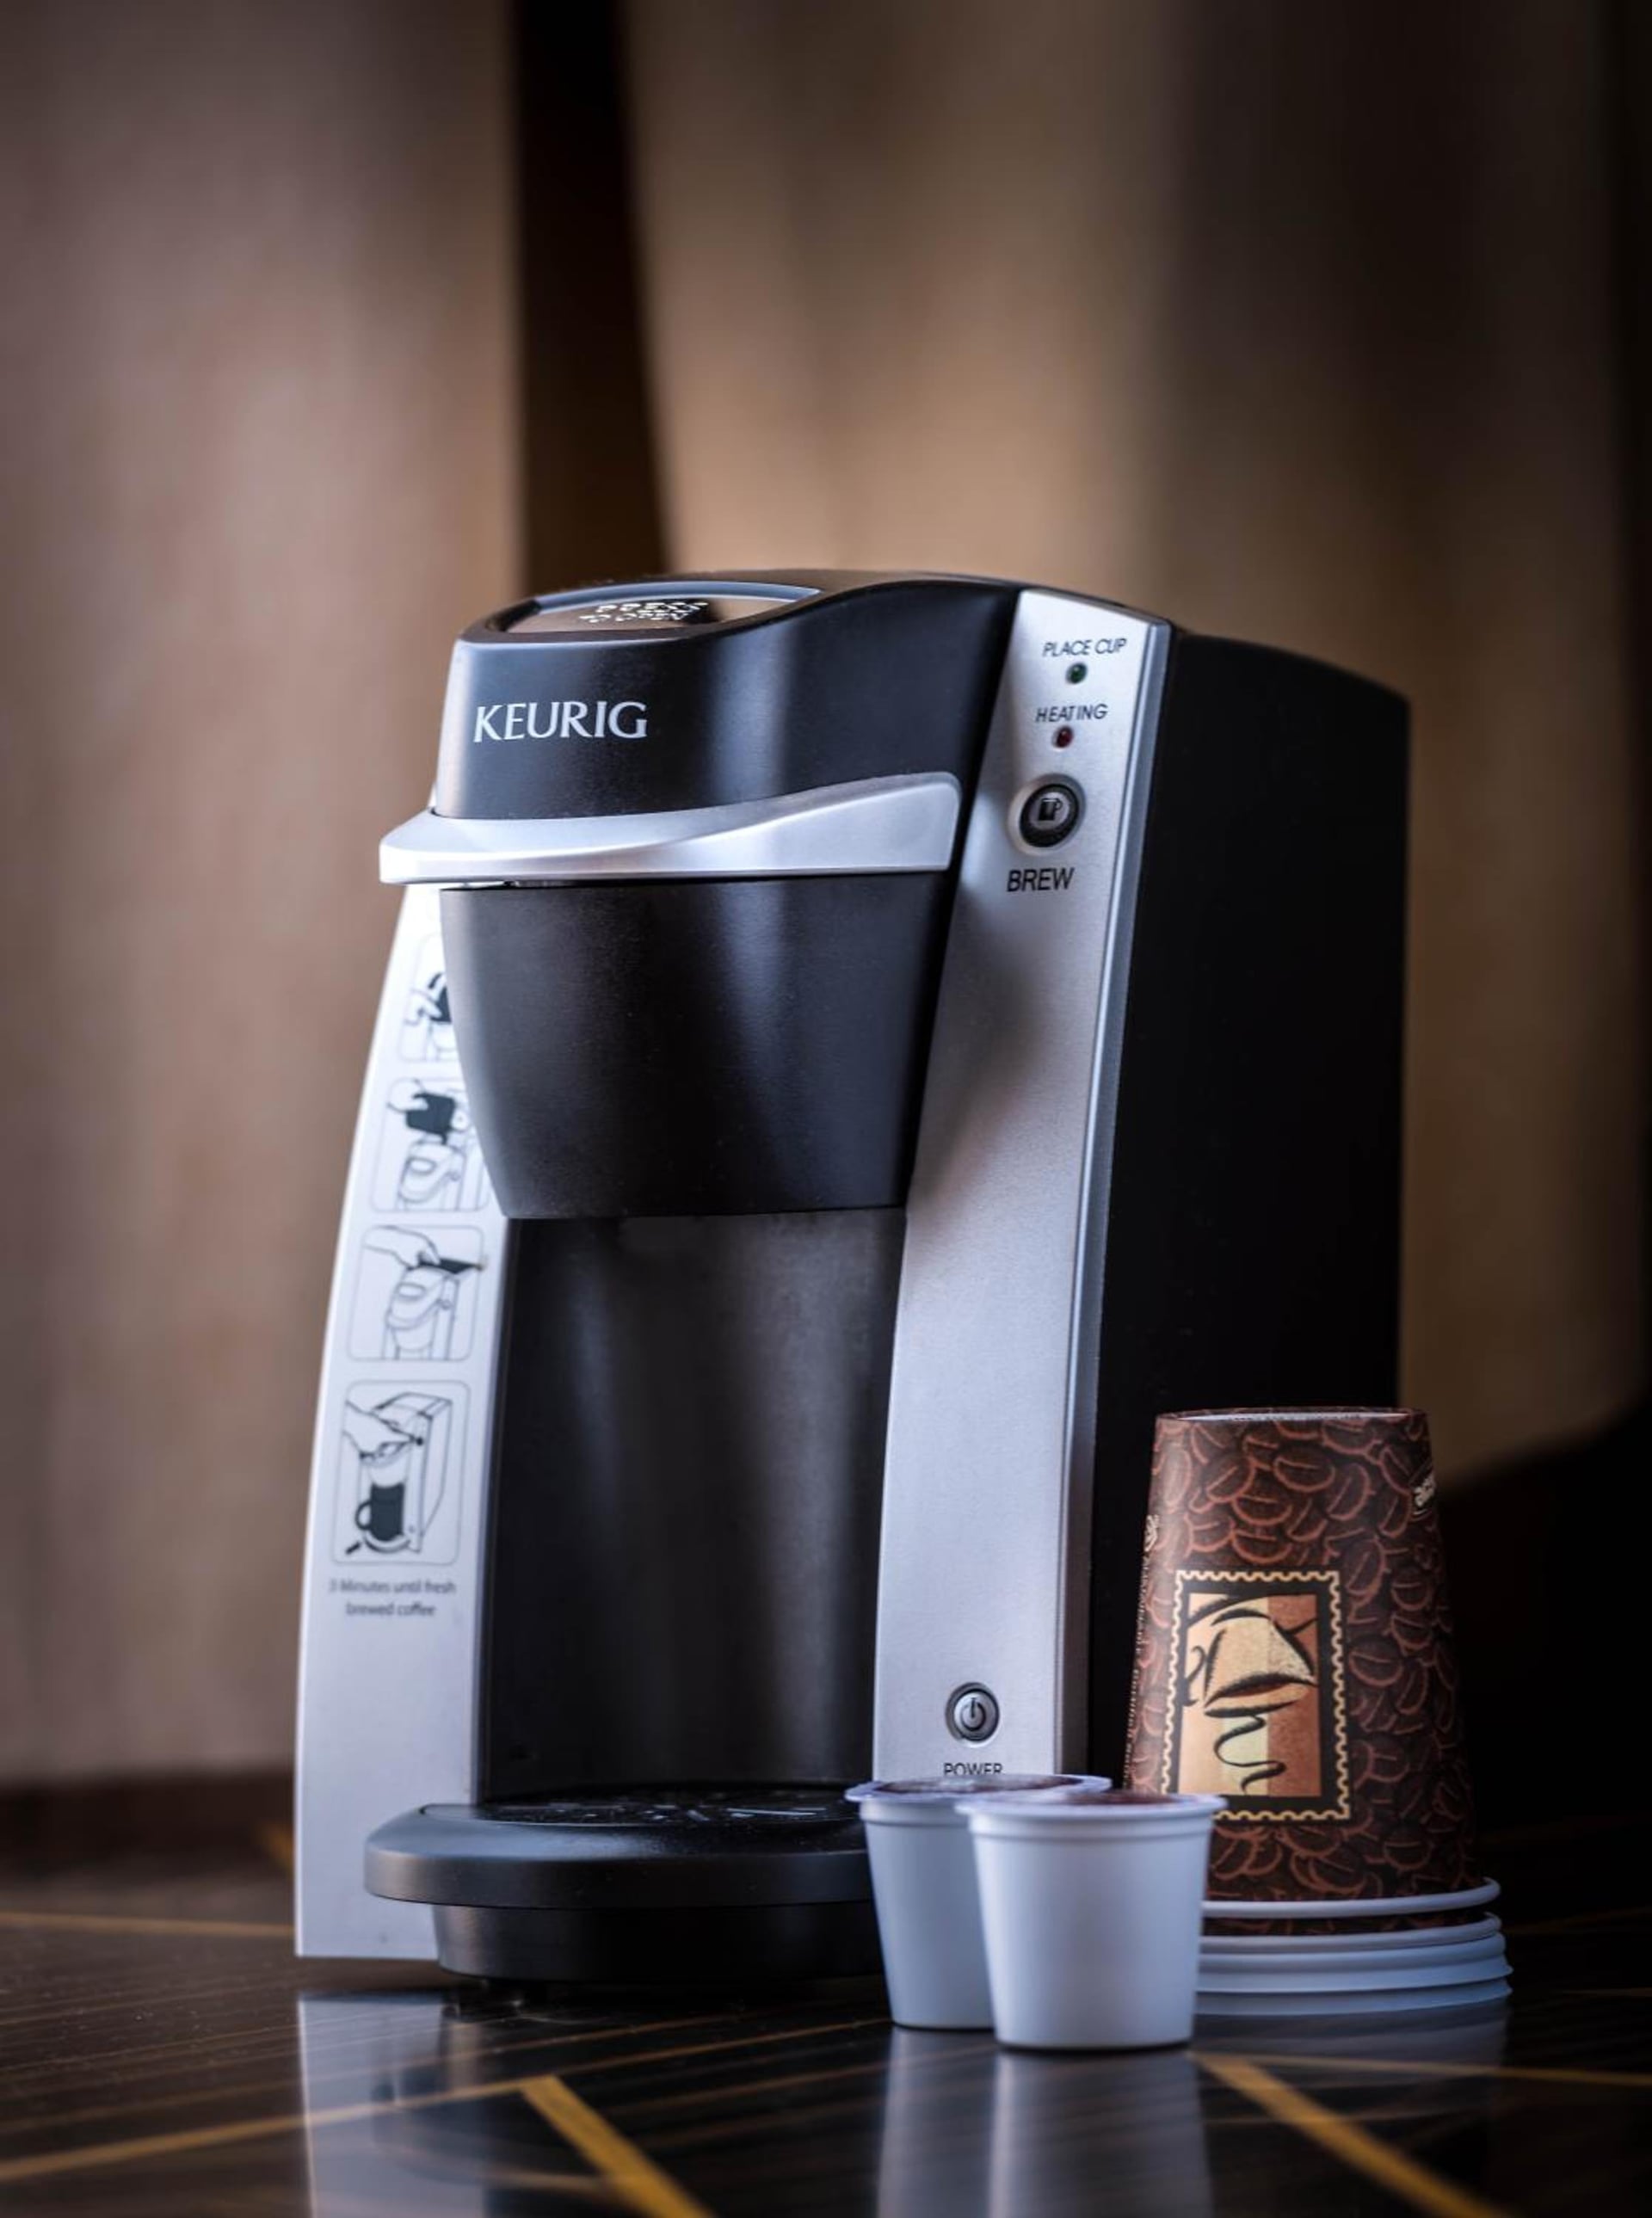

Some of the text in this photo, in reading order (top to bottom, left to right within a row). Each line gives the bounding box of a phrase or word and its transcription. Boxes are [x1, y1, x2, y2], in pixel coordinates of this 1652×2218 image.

[1042, 638, 1127, 657] PLACE CUP
[473, 700, 648, 742] KEURIG
[1035, 703, 1108, 723] HEATING
[1007, 867, 1075, 892] BREW
